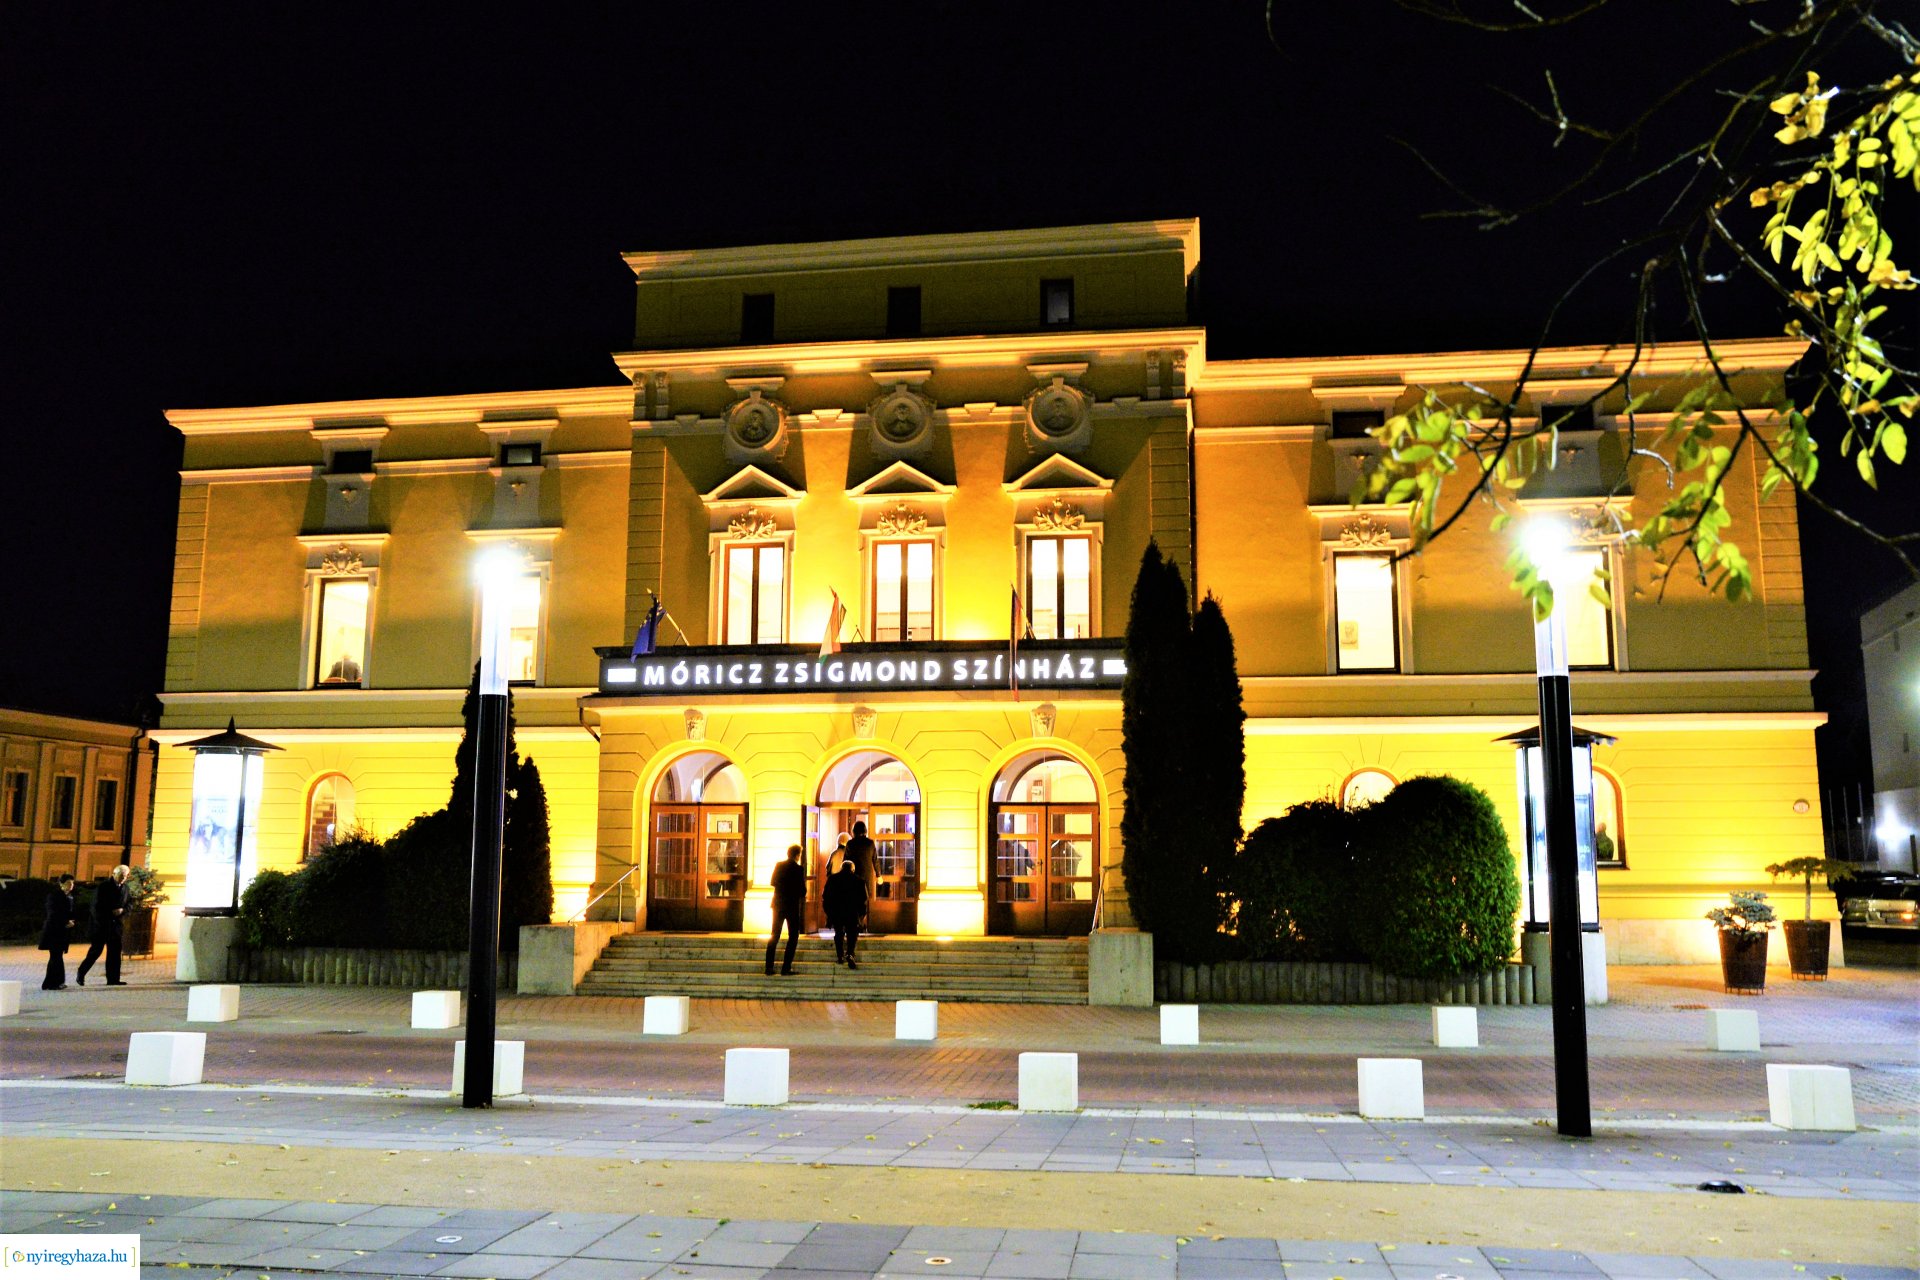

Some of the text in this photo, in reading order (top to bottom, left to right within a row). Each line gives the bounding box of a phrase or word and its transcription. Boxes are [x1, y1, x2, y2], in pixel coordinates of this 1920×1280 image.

[643, 654, 1095, 686] MÓRICZ ZSIGMOND SZÍNHÁZ
